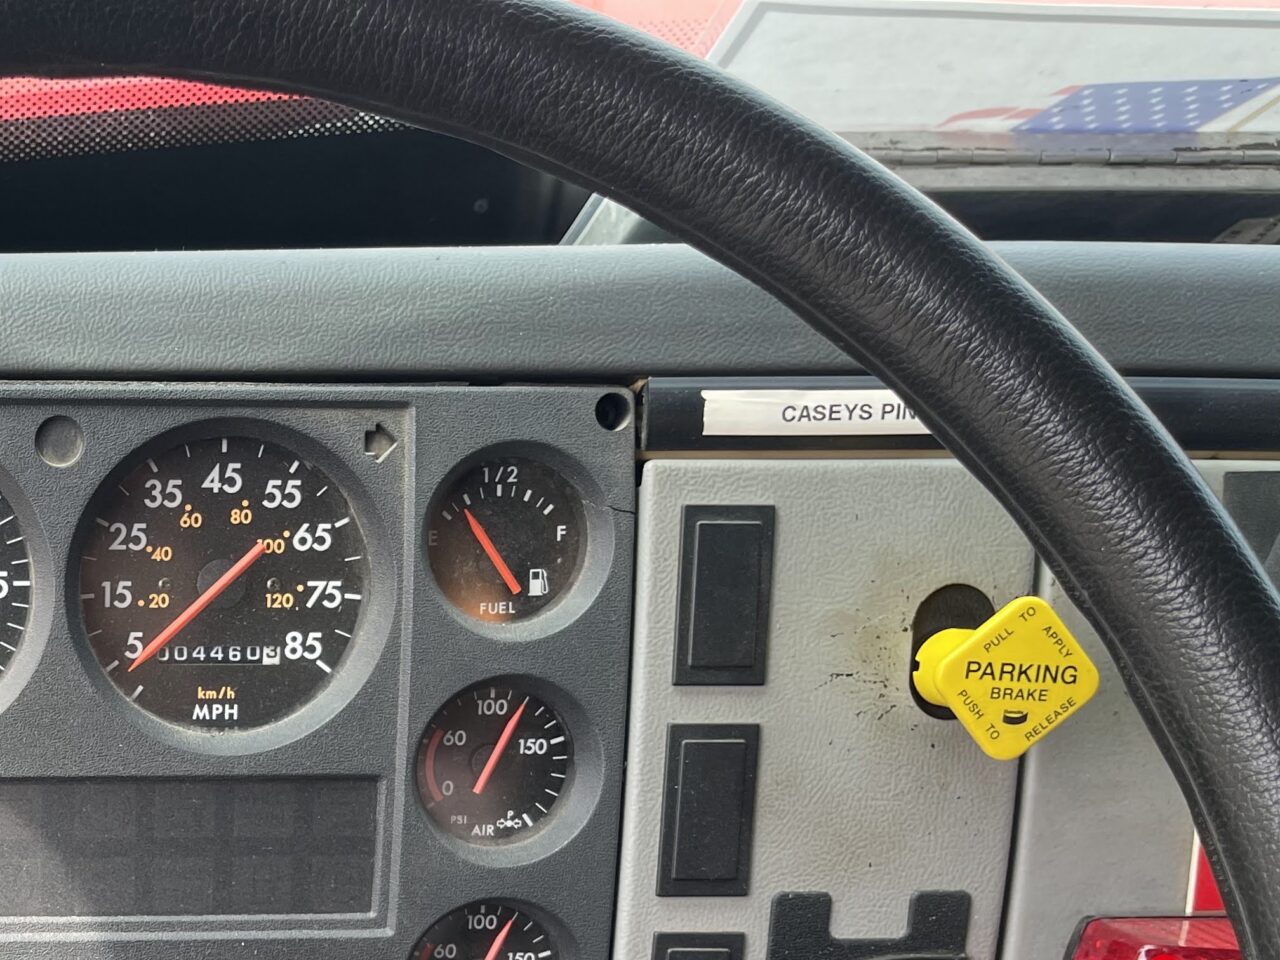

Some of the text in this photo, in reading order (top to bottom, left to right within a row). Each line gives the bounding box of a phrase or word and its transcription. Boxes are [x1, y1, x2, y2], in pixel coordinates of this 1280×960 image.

[781, 404, 873, 423] CASEYS
[201, 463, 243, 493] 45
[482, 466, 518, 483] 1/2
[144, 479, 182, 508] 35
[262, 480, 302, 508] 55
[179, 512, 202, 528] 60
[230, 509, 252, 525] 80
[109, 523, 148, 551] 25
[293, 523, 332, 551] 65
[428, 530, 438, 546] E
[557, 525, 567, 542] F
[151, 546, 172, 562] 40
[101, 581, 132, 608] 15
[149, 593, 169, 609] 20
[265, 593, 294, 609] 120
[306, 581, 342, 608] 75
[479, 602, 516, 615] FUEL
[983, 606, 1073, 659] PULL TO APPLY
[124, 632, 144, 659] 5
[284, 632, 323, 660] 85
[965, 660, 1078, 685] PARKING
[197, 686, 235, 700] km/h
[990, 687, 1049, 702] BRAKE
[192, 704, 238, 720] MPH
[477, 699, 508, 715] 100
[958, 689, 1077, 742] PUSH TO RELEASE
[443, 730, 466, 746] 60
[518, 738, 547, 754] 150
[442, 780, 453, 795] 0
[451, 815, 467, 824] PSI
[471, 824, 495, 836] AIR
[467, 915, 497, 930] 100
[434, 944, 456, 959] 60
